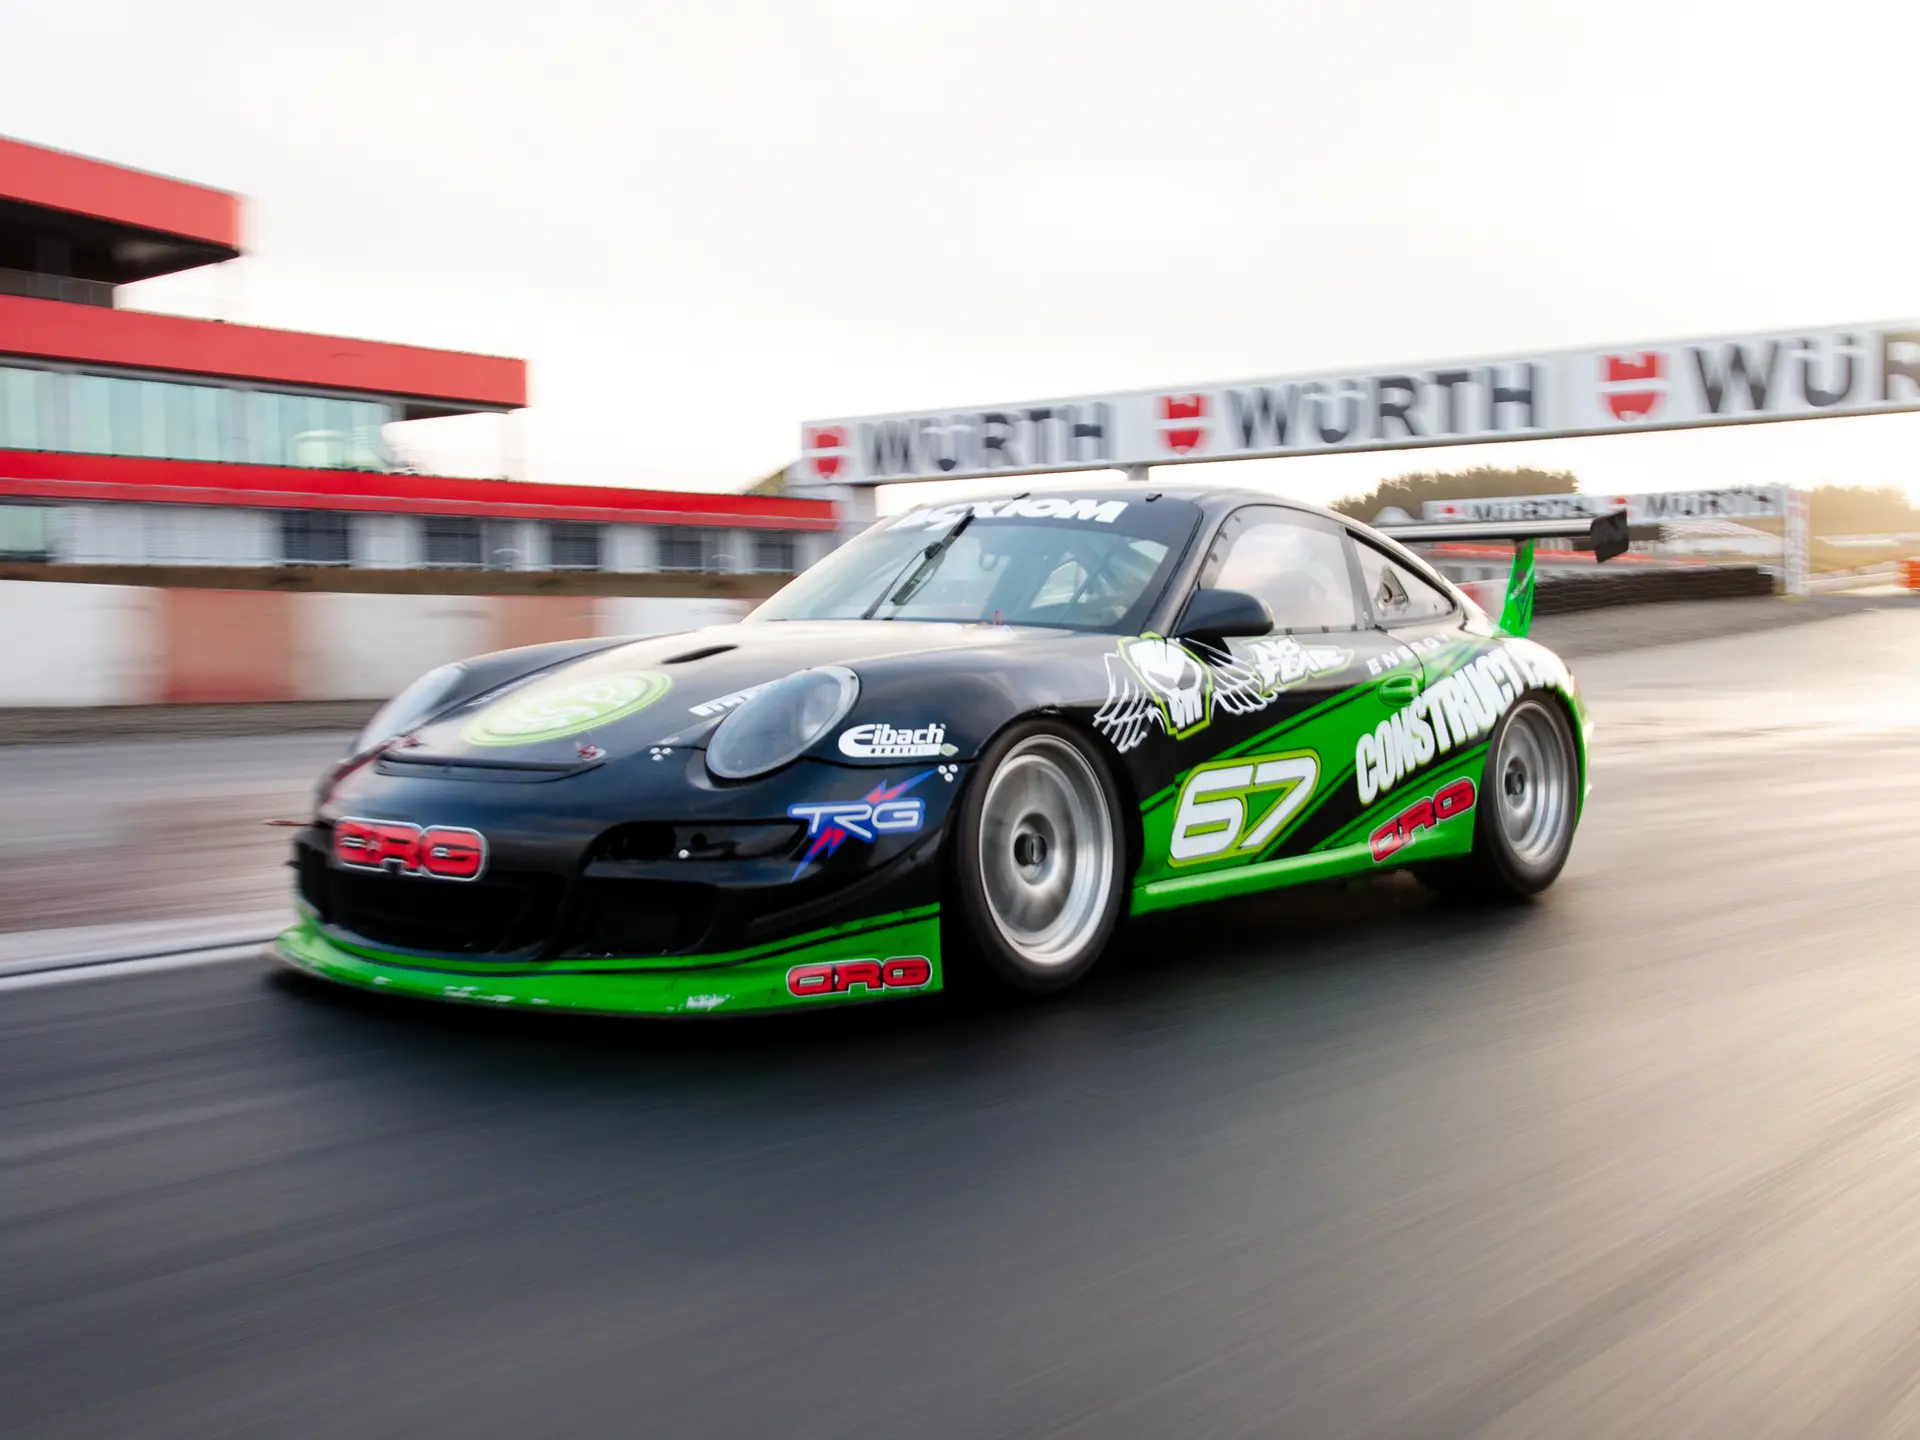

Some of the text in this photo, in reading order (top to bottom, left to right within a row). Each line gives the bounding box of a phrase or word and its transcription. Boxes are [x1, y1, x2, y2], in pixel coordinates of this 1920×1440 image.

[1224, 363, 1540, 449] WÜRTH
[858, 402, 1118, 475] WÜRTH
[1366, 632, 1450, 676] ENERGY
[838, 722, 945, 757] Eibach
[789, 800, 924, 840] TRG
[1169, 752, 1319, 864] 67
